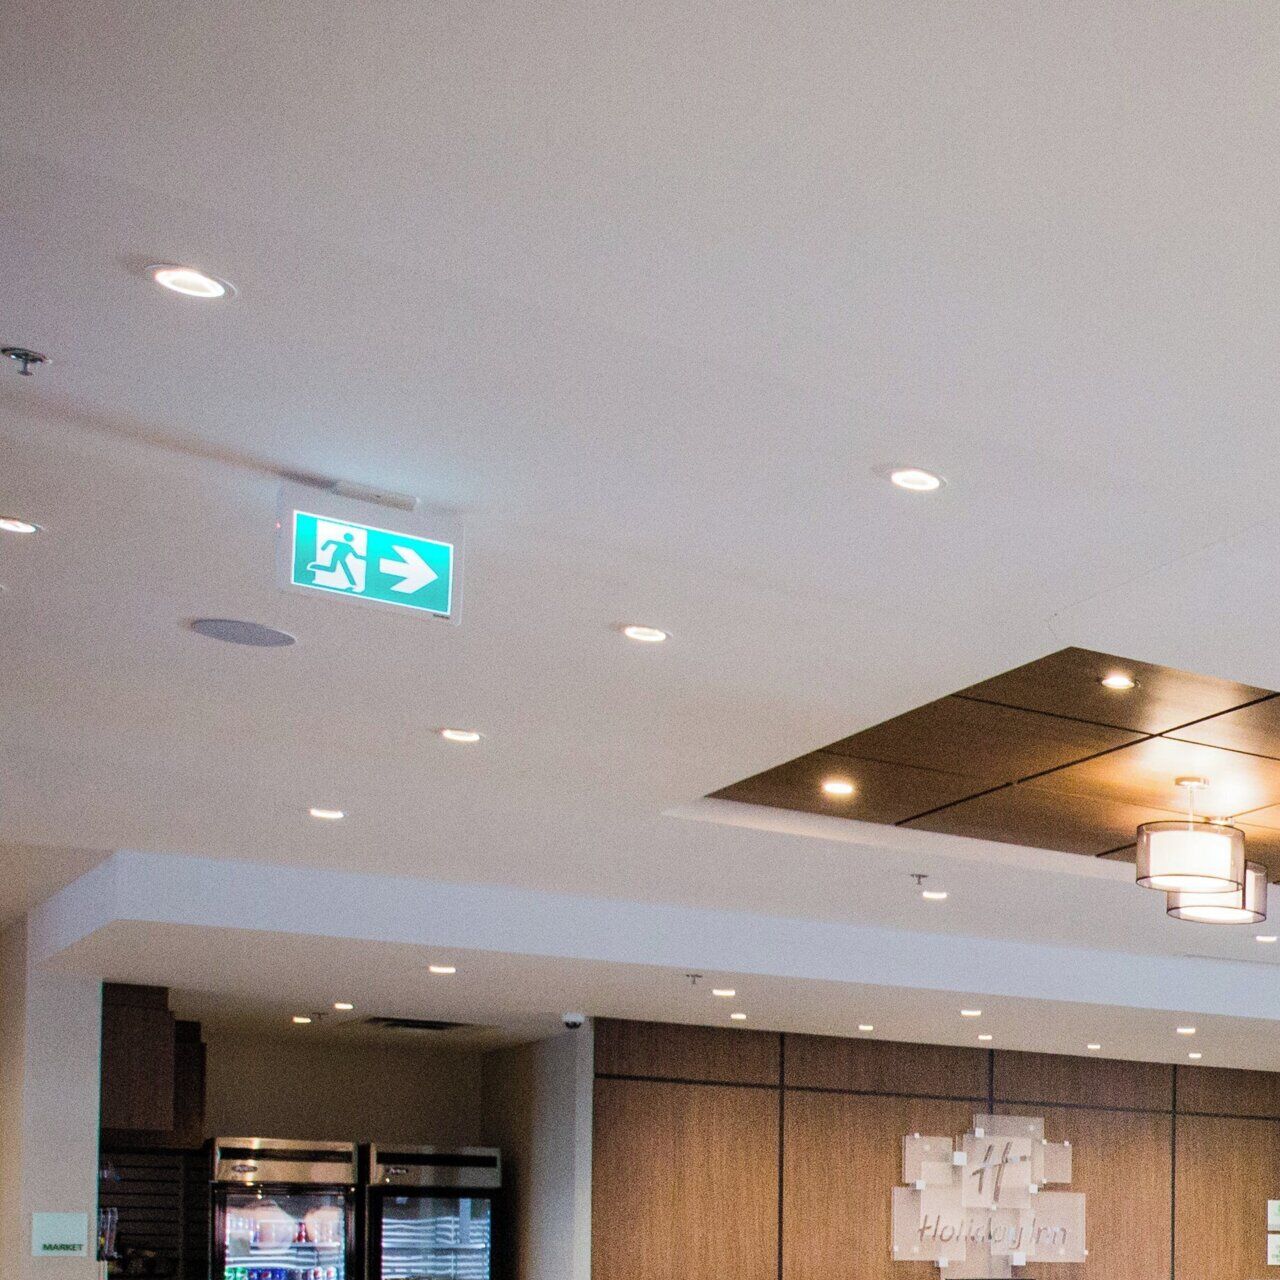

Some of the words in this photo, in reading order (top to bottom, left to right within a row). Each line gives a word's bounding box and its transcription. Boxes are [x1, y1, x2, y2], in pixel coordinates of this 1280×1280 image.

[917, 1213, 1024, 1250] Holiday
[1029, 1217, 1068, 1245] Inn
[42, 1243, 84, 1251] MARKET
